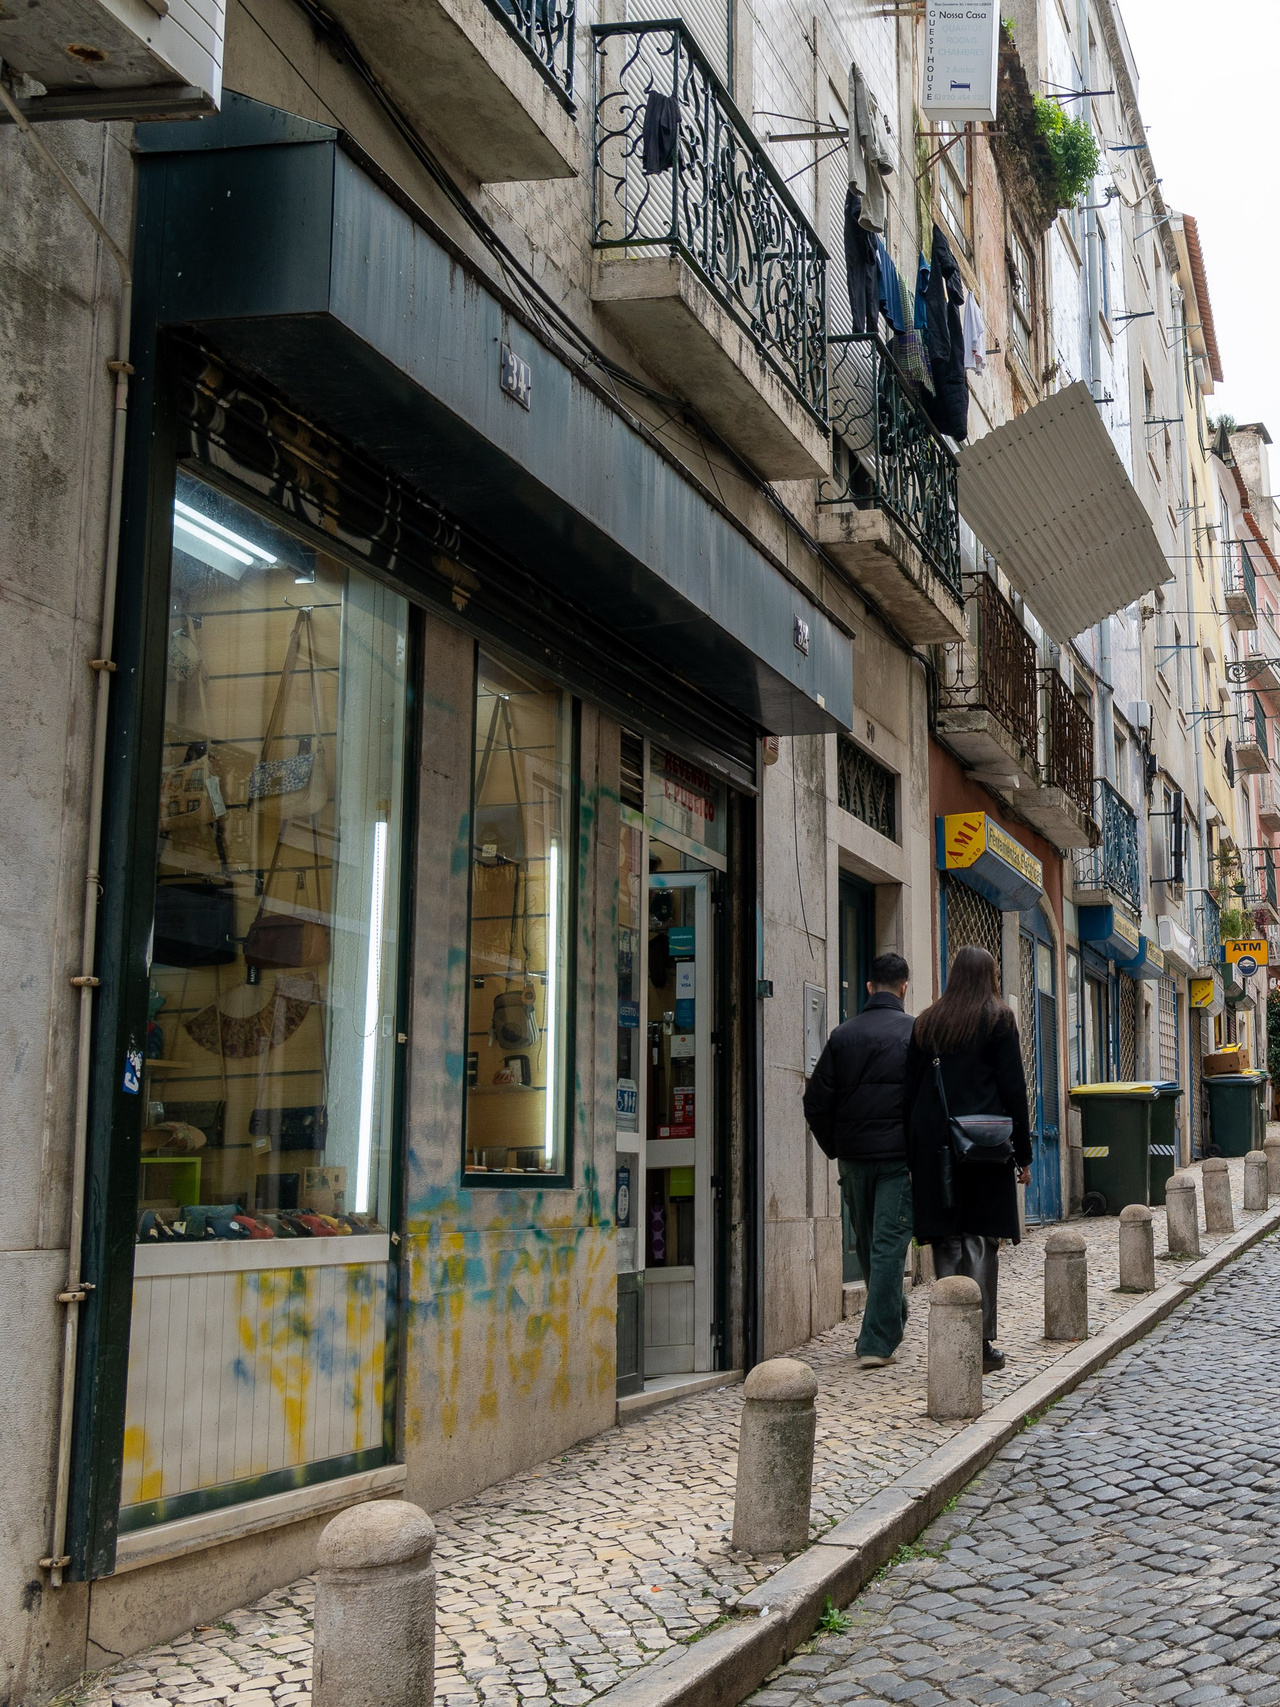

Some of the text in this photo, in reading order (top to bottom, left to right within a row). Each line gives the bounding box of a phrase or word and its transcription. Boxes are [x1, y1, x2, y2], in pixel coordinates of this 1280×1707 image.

[939, 11, 986, 19] Nossa Casa
[926, 10, 936, 101] GUESTHOUSE
[508, 354, 527, 401] 34
[664, 777, 671, 800] E
[947, 820, 982, 865] AML
[1233, 943, 1261, 951] ATM
